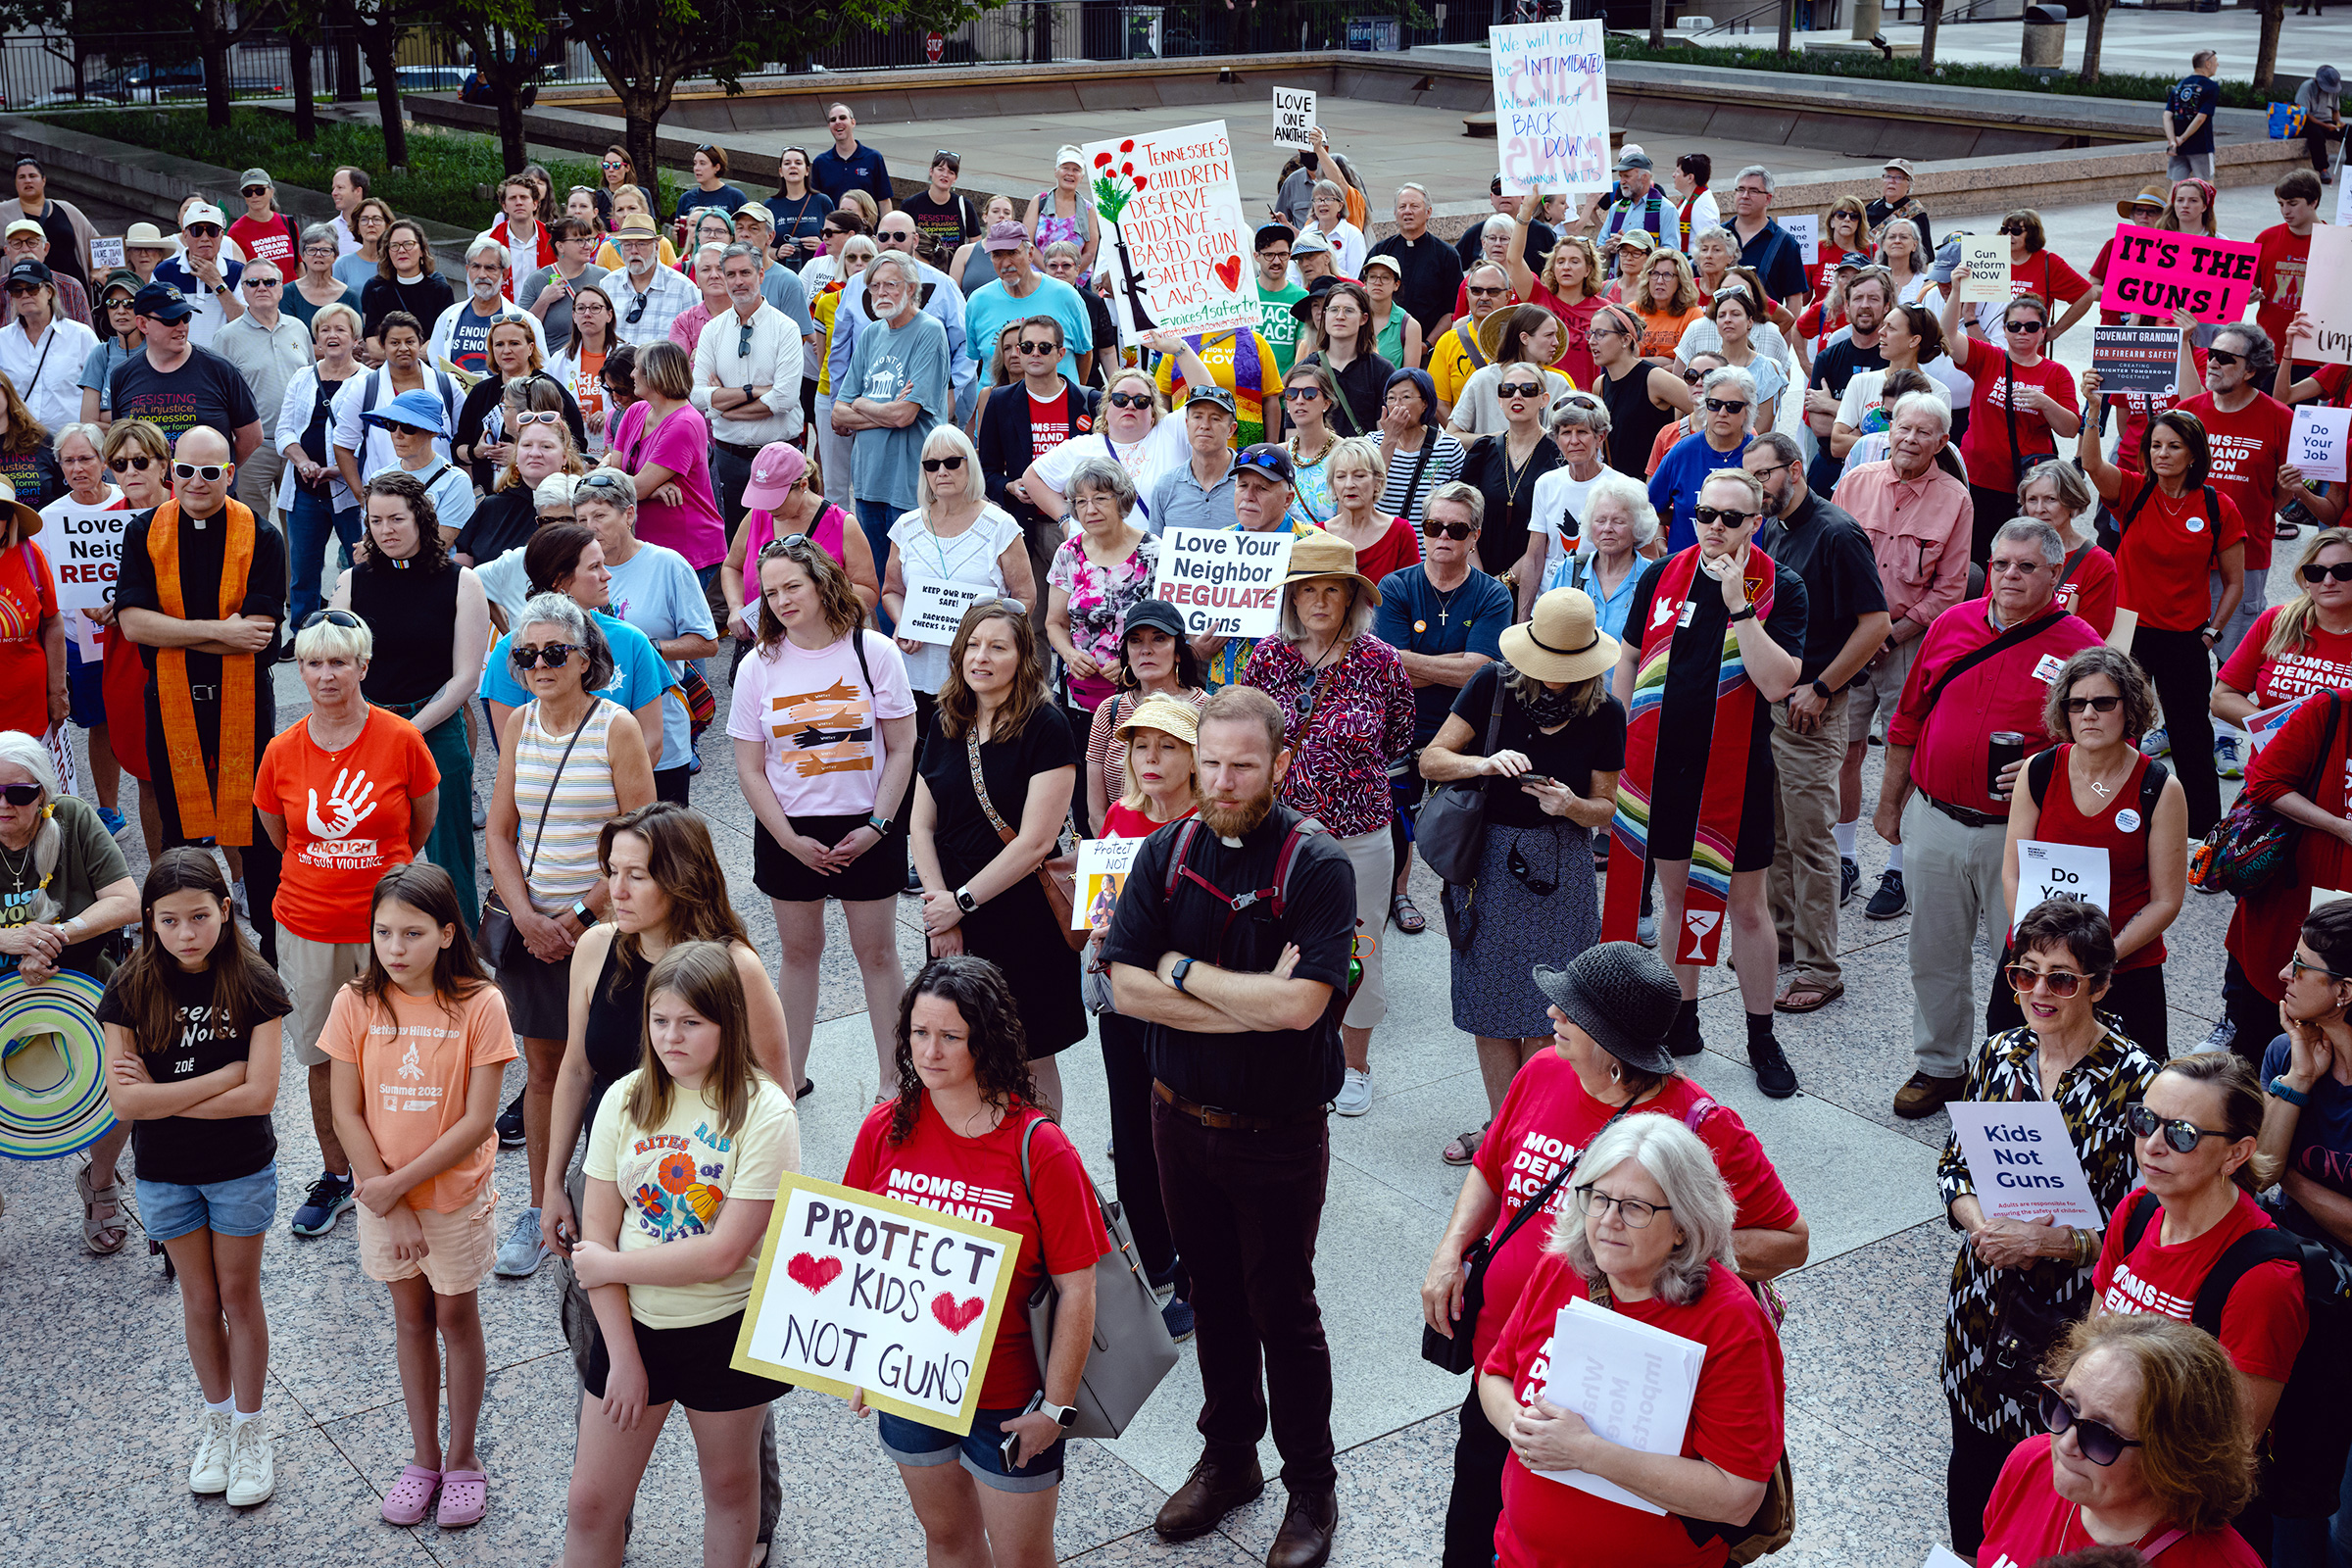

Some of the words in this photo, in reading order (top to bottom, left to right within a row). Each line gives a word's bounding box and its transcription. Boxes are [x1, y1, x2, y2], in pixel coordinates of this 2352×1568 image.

[1526, 29, 1549, 48] will
[1559, 25, 1585, 46] not
[927, 39, 942, 51] STOP
[1497, 60, 1513, 76] be
[1524, 53, 1603, 76] INTIMIDATED.
[1276, 93, 1311, 113] LOVE
[1499, 91, 1523, 110] We
[1528, 88, 1550, 108] will
[1557, 86, 1582, 107] not
[1283, 113, 1305, 127] ONE
[1512, 112, 1562, 136] BACK
[1142, 133, 1229, 167] TENNESSEE'S
[1150, 161, 1229, 191] CHILDREN
[1517, 172, 1558, 186] SHANNON
[1563, 167, 1602, 183] WATTS
[1128, 185, 1211, 220] DESERVE
[251, 235, 277, 247] MOMS
[254, 241, 288, 253] DEMAND
[1132, 240, 1191, 268] BASED
[1198, 229, 1238, 257] GUN
[257, 248, 288, 259] ACTION
[1974, 250, 1997, 259] Gun
[2119, 235, 2180, 269] IT'S
[2191, 247, 2256, 280] THE
[1148, 257, 1214, 289] SAFETY
[1966, 261, 2005, 270] Reform
[1972, 270, 2000, 279] NOW
[1151, 281, 1213, 313] LAWS.
[1159, 295, 1257, 328] #voices4safertn
[1263, 306, 1298, 324] ACH
[460, 325, 490, 338] ENOU
[2095, 331, 2137, 342] COVENANT
[2138, 332, 2179, 343] GRANDMA
[463, 339, 488, 351] ENO
[1202, 354, 1235, 365] LOV
[1996, 375, 2026, 389] MMS
[131, 393, 196, 406] RESISTING
[137, 413, 196, 422] oppression
[1032, 432, 1064, 442] MAND
[2311, 424, 2328, 435] Do
[1033, 443, 1057, 453] TION
[2303, 436, 2333, 448] Your
[2303, 449, 2328, 461] Job
[2224, 473, 2249, 482] AMERICA
[16, 486, 41, 496] sent
[63, 516, 123, 534] Love
[1175, 531, 1227, 554] Love
[1235, 535, 1281, 556] Your
[1173, 558, 1273, 585] Neighbor
[922, 585, 941, 595] KEEP
[1158, 582, 1278, 609] REGULATE
[939, 598, 959, 608] SAFE!
[911, 619, 939, 630] CHECKS
[922, 612, 962, 624] BACKGROU
[2278, 652, 2334, 672] MOMS
[2273, 664, 2352, 688] DEMAND
[2269, 676, 2330, 695] ACTIO
[2267, 689, 2278, 698] FOR
[2278, 691, 2293, 701] GUN
[311, 842, 373, 855] ENOUGH
[1094, 840, 1134, 856] Protect
[314, 857, 333, 869] GUN
[336, 856, 384, 869] VIOLENCE
[1105, 858, 1128, 870] NOT
[2051, 867, 2079, 884] Do
[410, 1025, 432, 1037] Hills
[432, 1027, 460, 1039] Camp
[173, 1057, 194, 1073] ZOË
[379, 1083, 416, 1097] Summer
[417, 1086, 443, 1097] 2022
[694, 1121, 732, 1152] RAB
[1984, 1124, 2042, 1142] Kids
[634, 1134, 690, 1155] RITES
[1522, 1131, 1575, 1163] MOM
[1993, 1149, 2043, 1165] Not
[700, 1162, 724, 1179] of
[888, 1168, 967, 1200] MOMS
[1996, 1171, 2065, 1189] Guns
[804, 1201, 996, 1285] PROTECT
[849, 1263, 925, 1323] KIDS
[780, 1313, 867, 1372] NOT
[878, 1343, 969, 1404] GUNS
